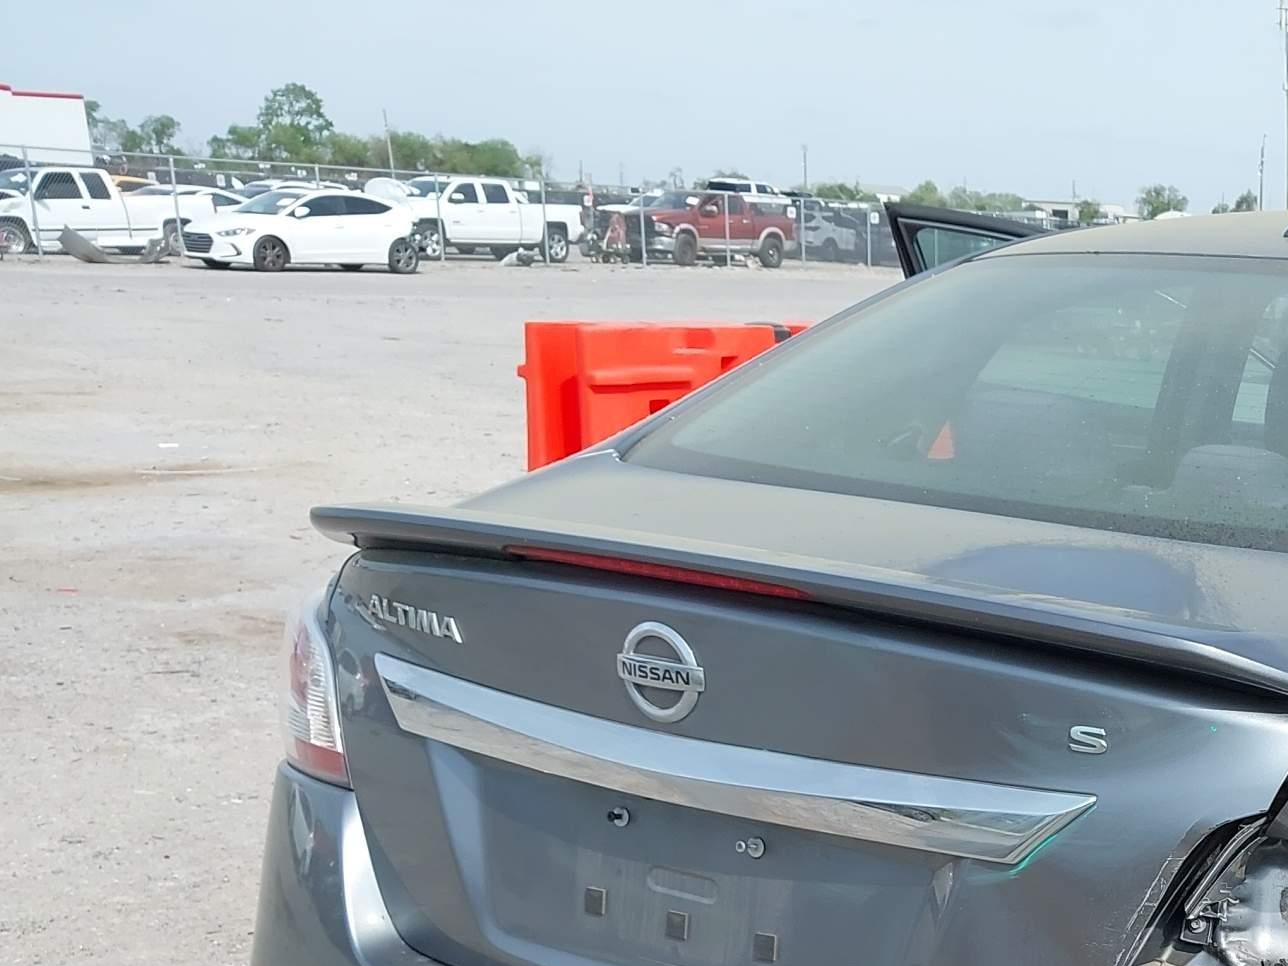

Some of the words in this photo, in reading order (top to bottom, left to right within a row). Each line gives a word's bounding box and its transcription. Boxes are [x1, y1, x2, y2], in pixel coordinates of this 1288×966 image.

[367, 593, 463, 644] ALTIMA
[621, 660, 691, 686] NISSAN
[1069, 725, 1108, 754] S
